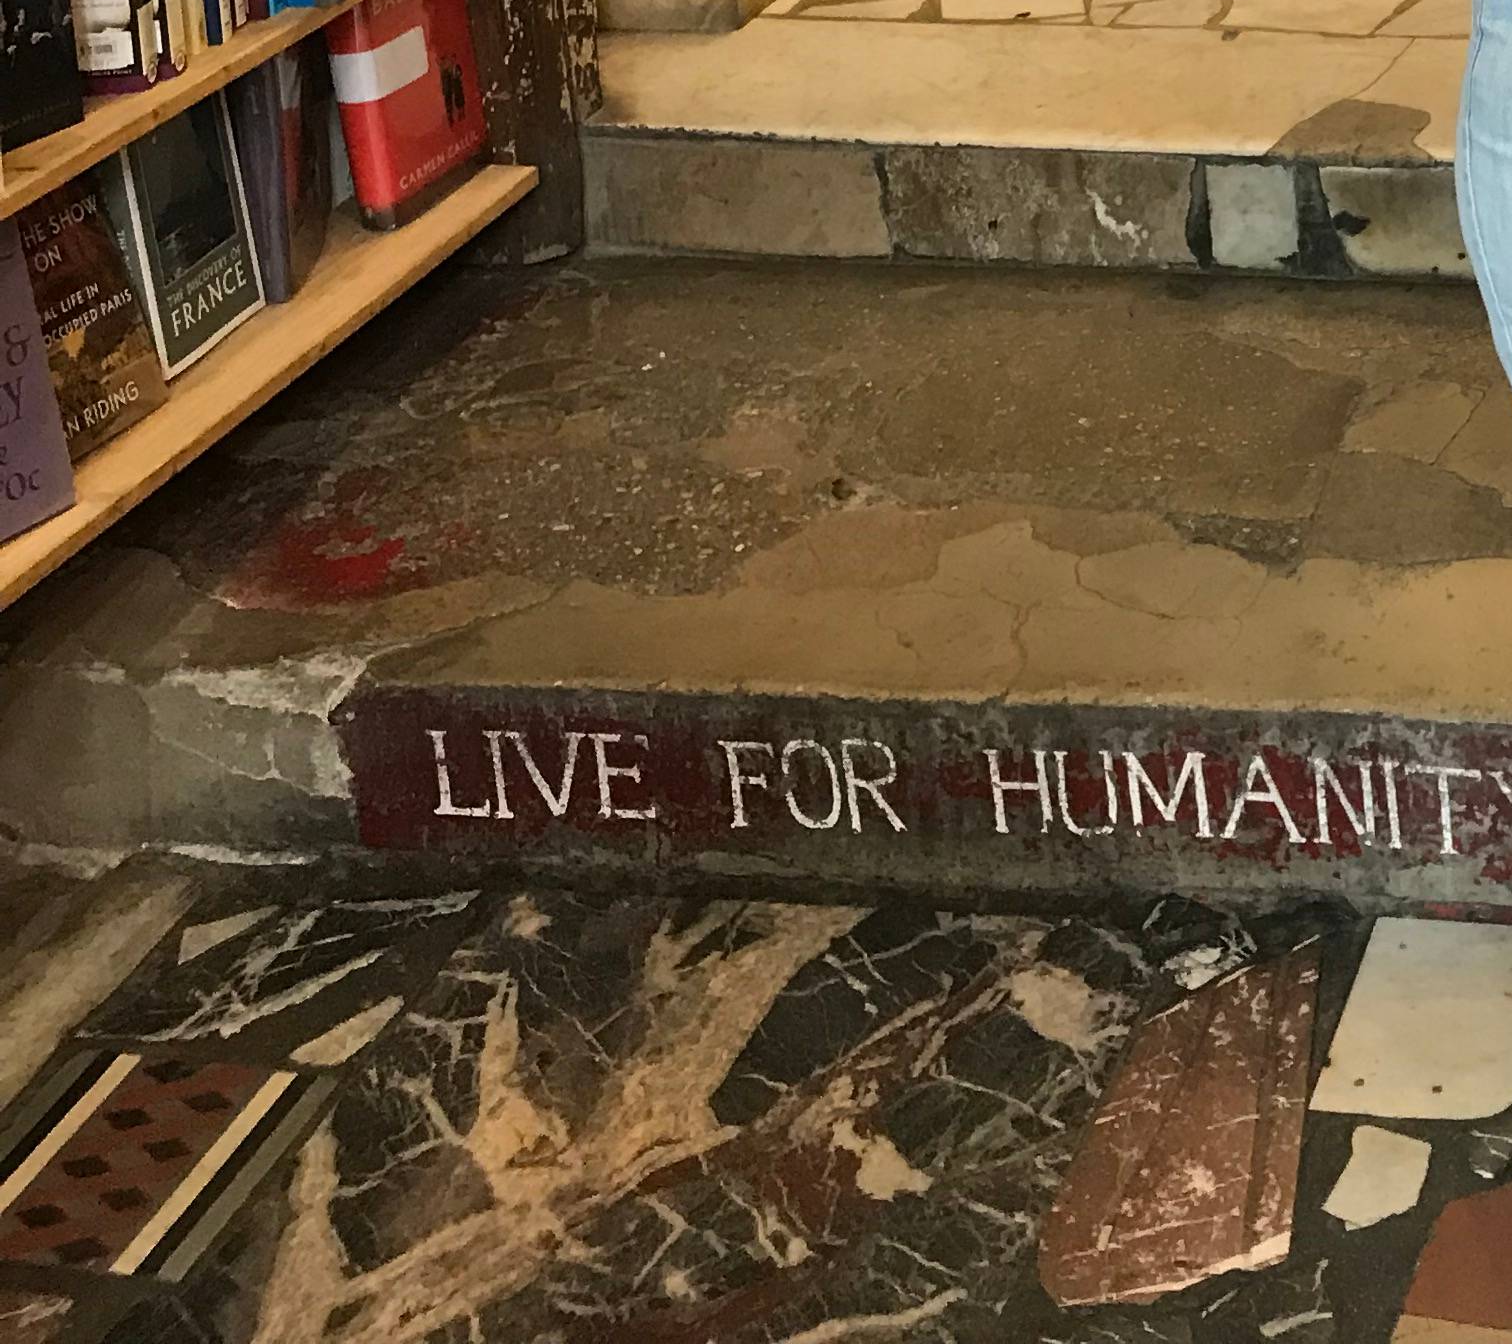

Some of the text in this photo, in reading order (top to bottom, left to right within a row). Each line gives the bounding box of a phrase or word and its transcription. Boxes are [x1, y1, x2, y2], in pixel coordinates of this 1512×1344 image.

[399, 151, 446, 191] CARMEN
[50, 193, 98, 237] SHOW
[34, 244, 63, 273] ON
[44, 288, 133, 348] OCCUPIED PARIS
[61, 282, 100, 314] LIFE IN
[170, 260, 248, 338] FRANCE
[83, 379, 140, 429] RIDING
[428, 729, 658, 820] LIVE
[724, 737, 908, 835] FOR
